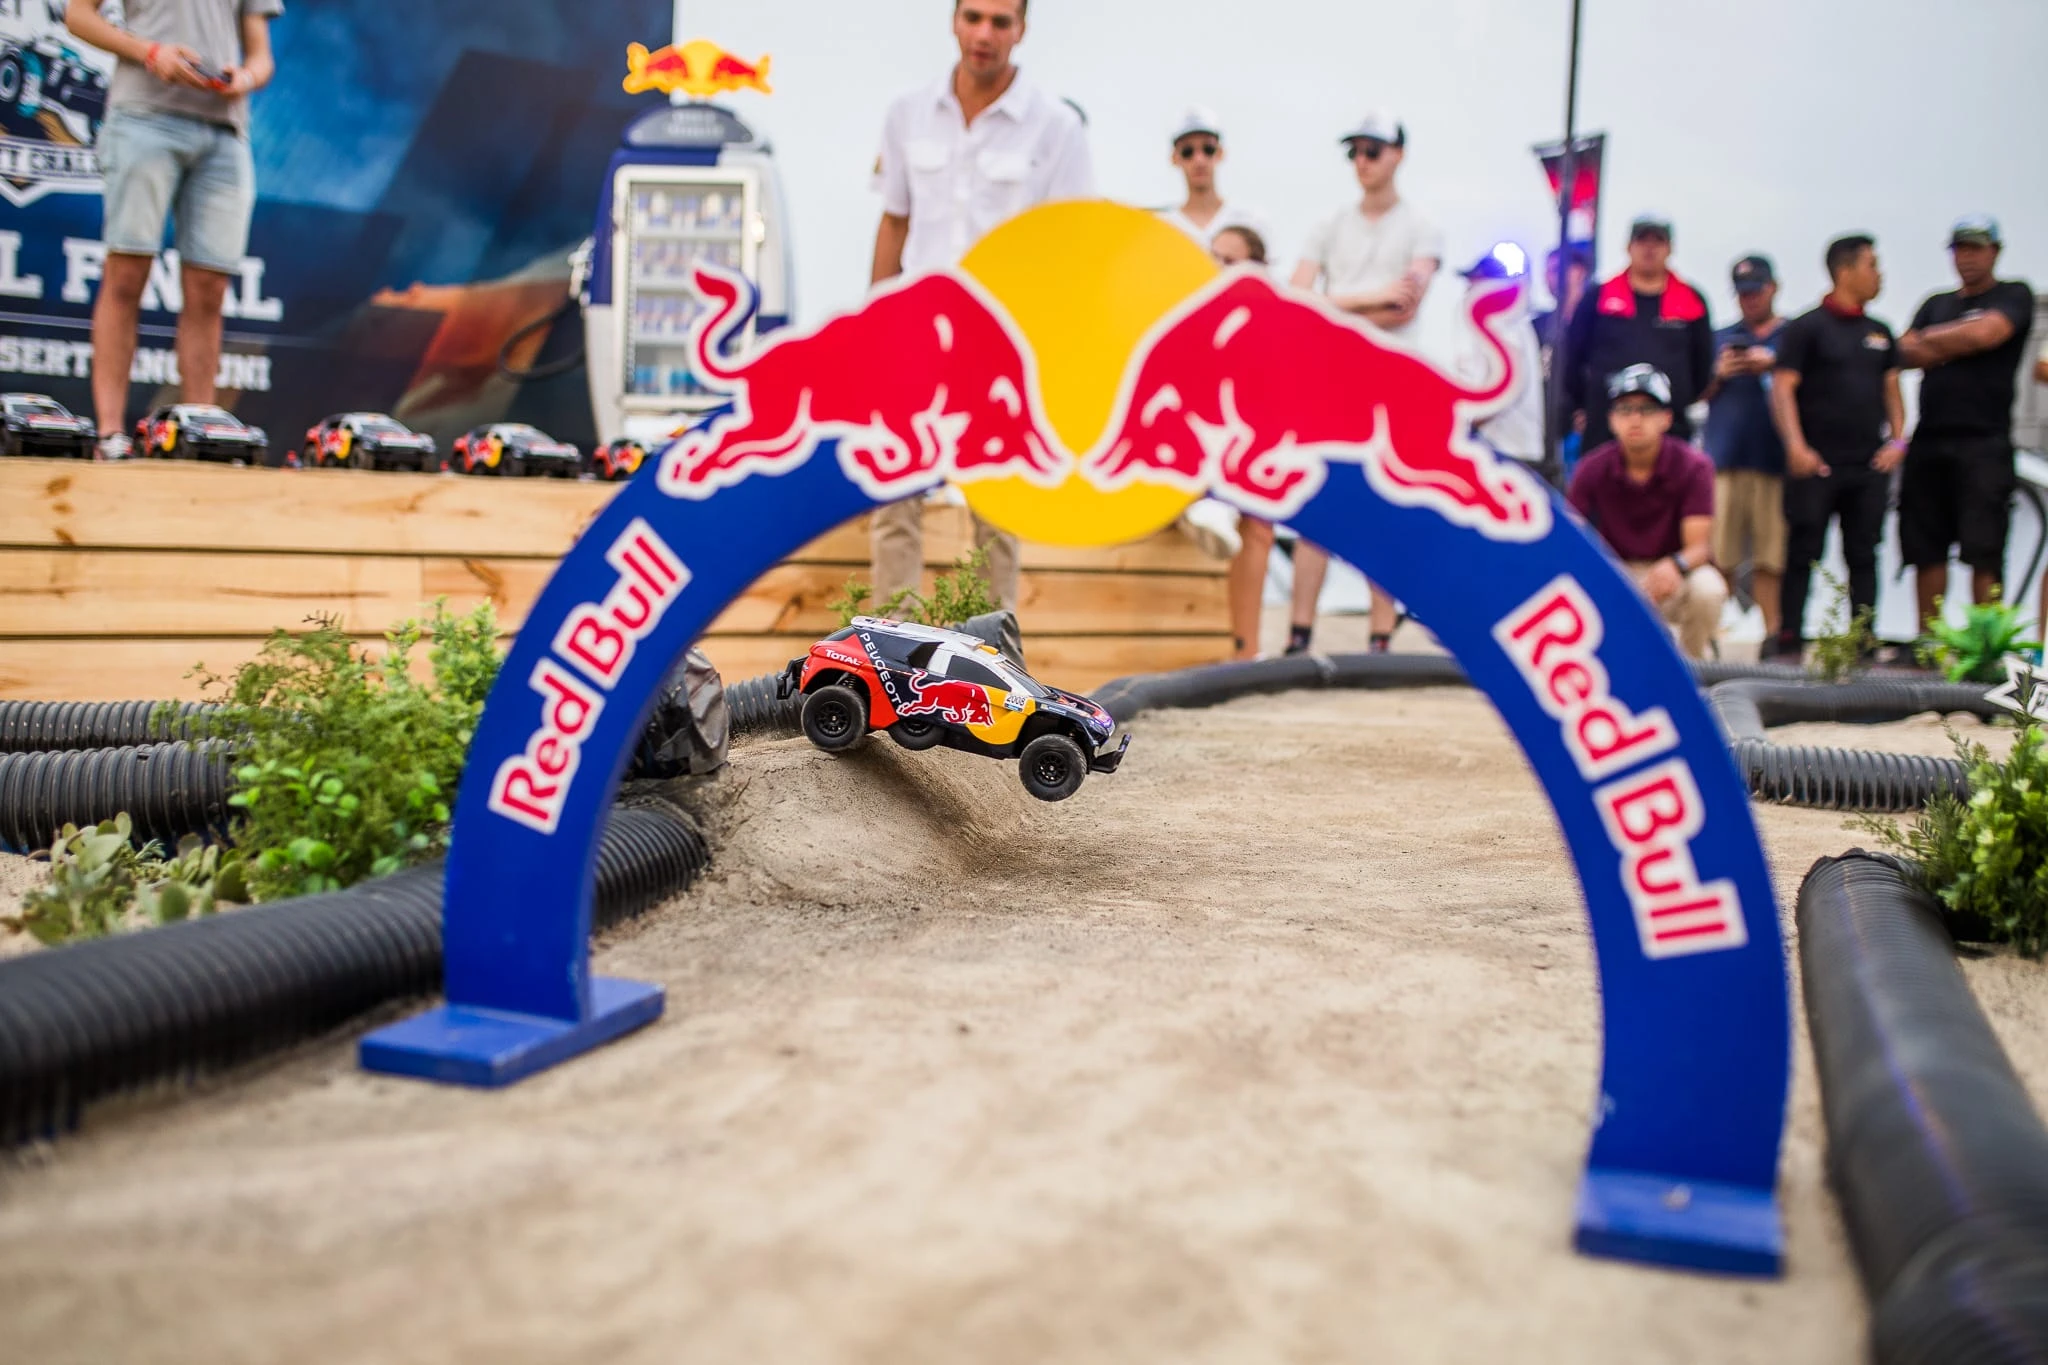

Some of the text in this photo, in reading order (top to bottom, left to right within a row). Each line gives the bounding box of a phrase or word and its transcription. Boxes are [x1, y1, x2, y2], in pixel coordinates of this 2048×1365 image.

[62, 237, 284, 322] FNL
[501, 533, 680, 823] Red Bull
[825, 648, 863, 666] TOTAL
[860, 632, 902, 704] PEUGEOT
[1510, 593, 1730, 943] Red Bull
